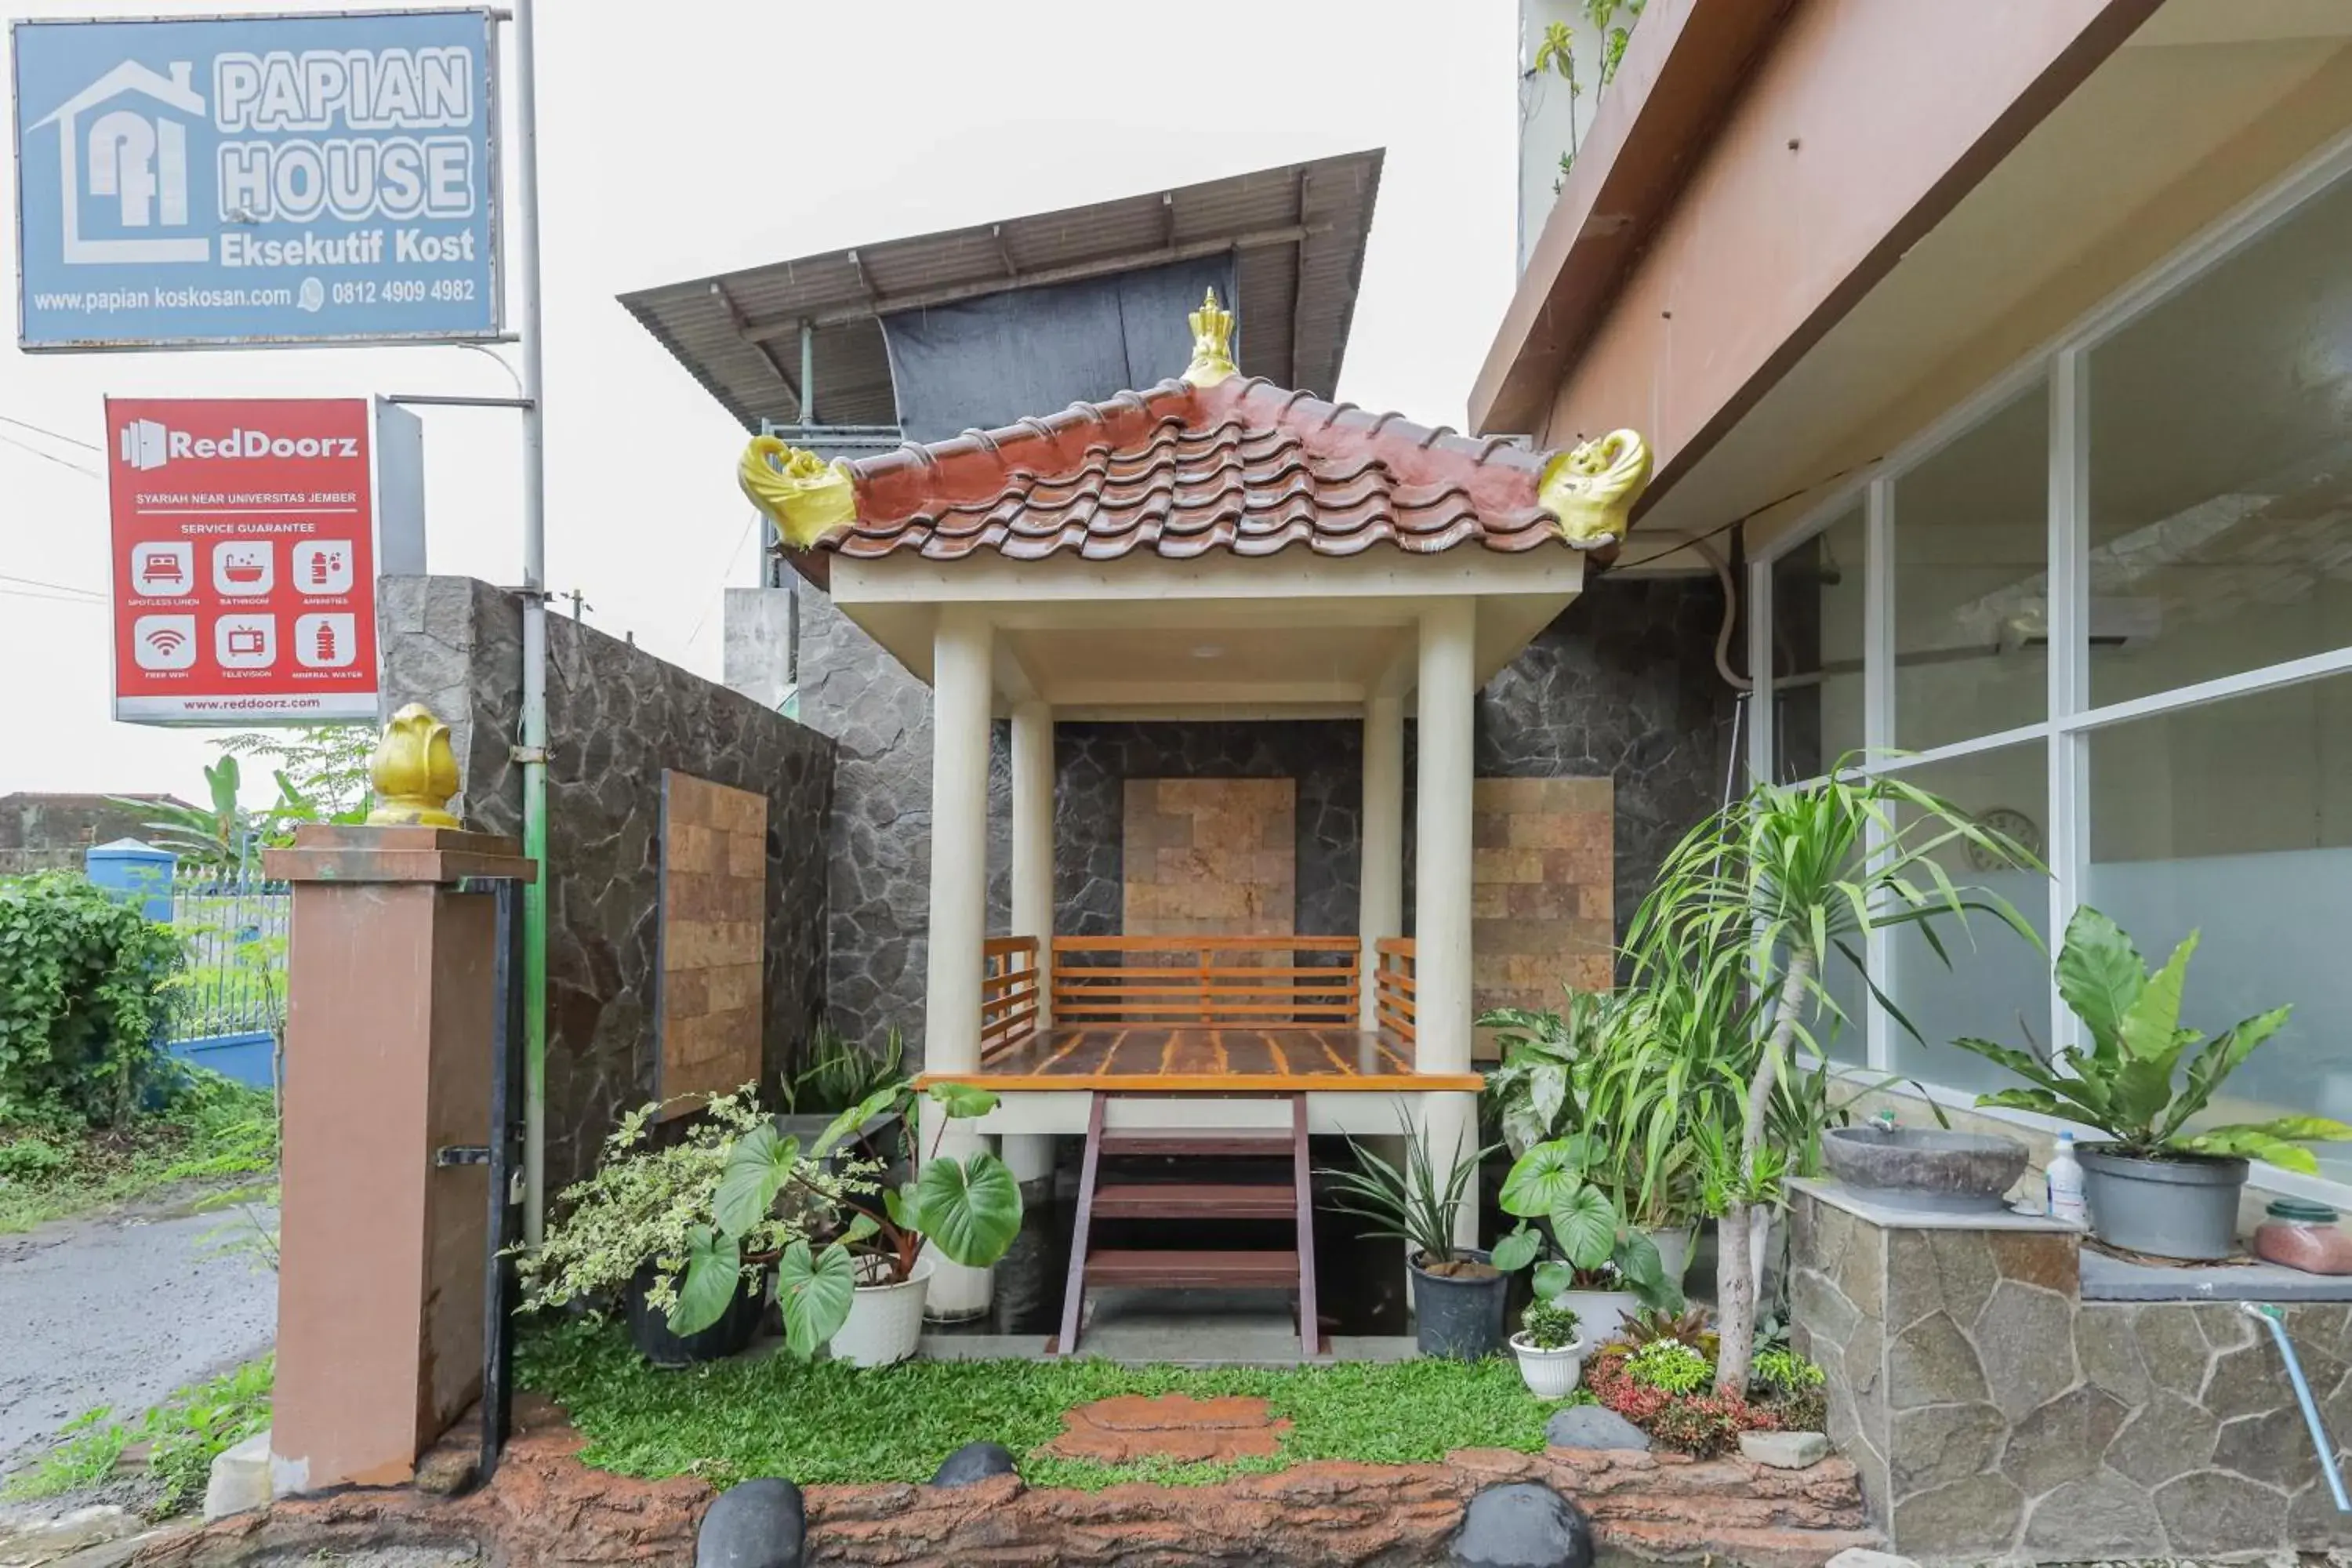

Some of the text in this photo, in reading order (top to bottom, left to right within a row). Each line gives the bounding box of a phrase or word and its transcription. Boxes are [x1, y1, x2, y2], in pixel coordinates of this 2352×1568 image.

[214, 47, 474, 132] PAPIAN
[217, 136, 475, 223] HOUSE
[220, 227, 474, 267] Eksekutif Kost
[154, 286, 291, 308] koskosan.com
[332, 280, 376, 304] 0812
[381, 280, 426, 303] 4909
[430, 278, 474, 301] 4982
[169, 428, 358, 458] RedDoorz
[136, 492, 357, 504] SYARIAH NEAR UNIVERSITAS JEMBER
[181, 522, 316, 534] SERVICE GUARANTEE
[184, 698, 320, 709] www.reddoorz.com
